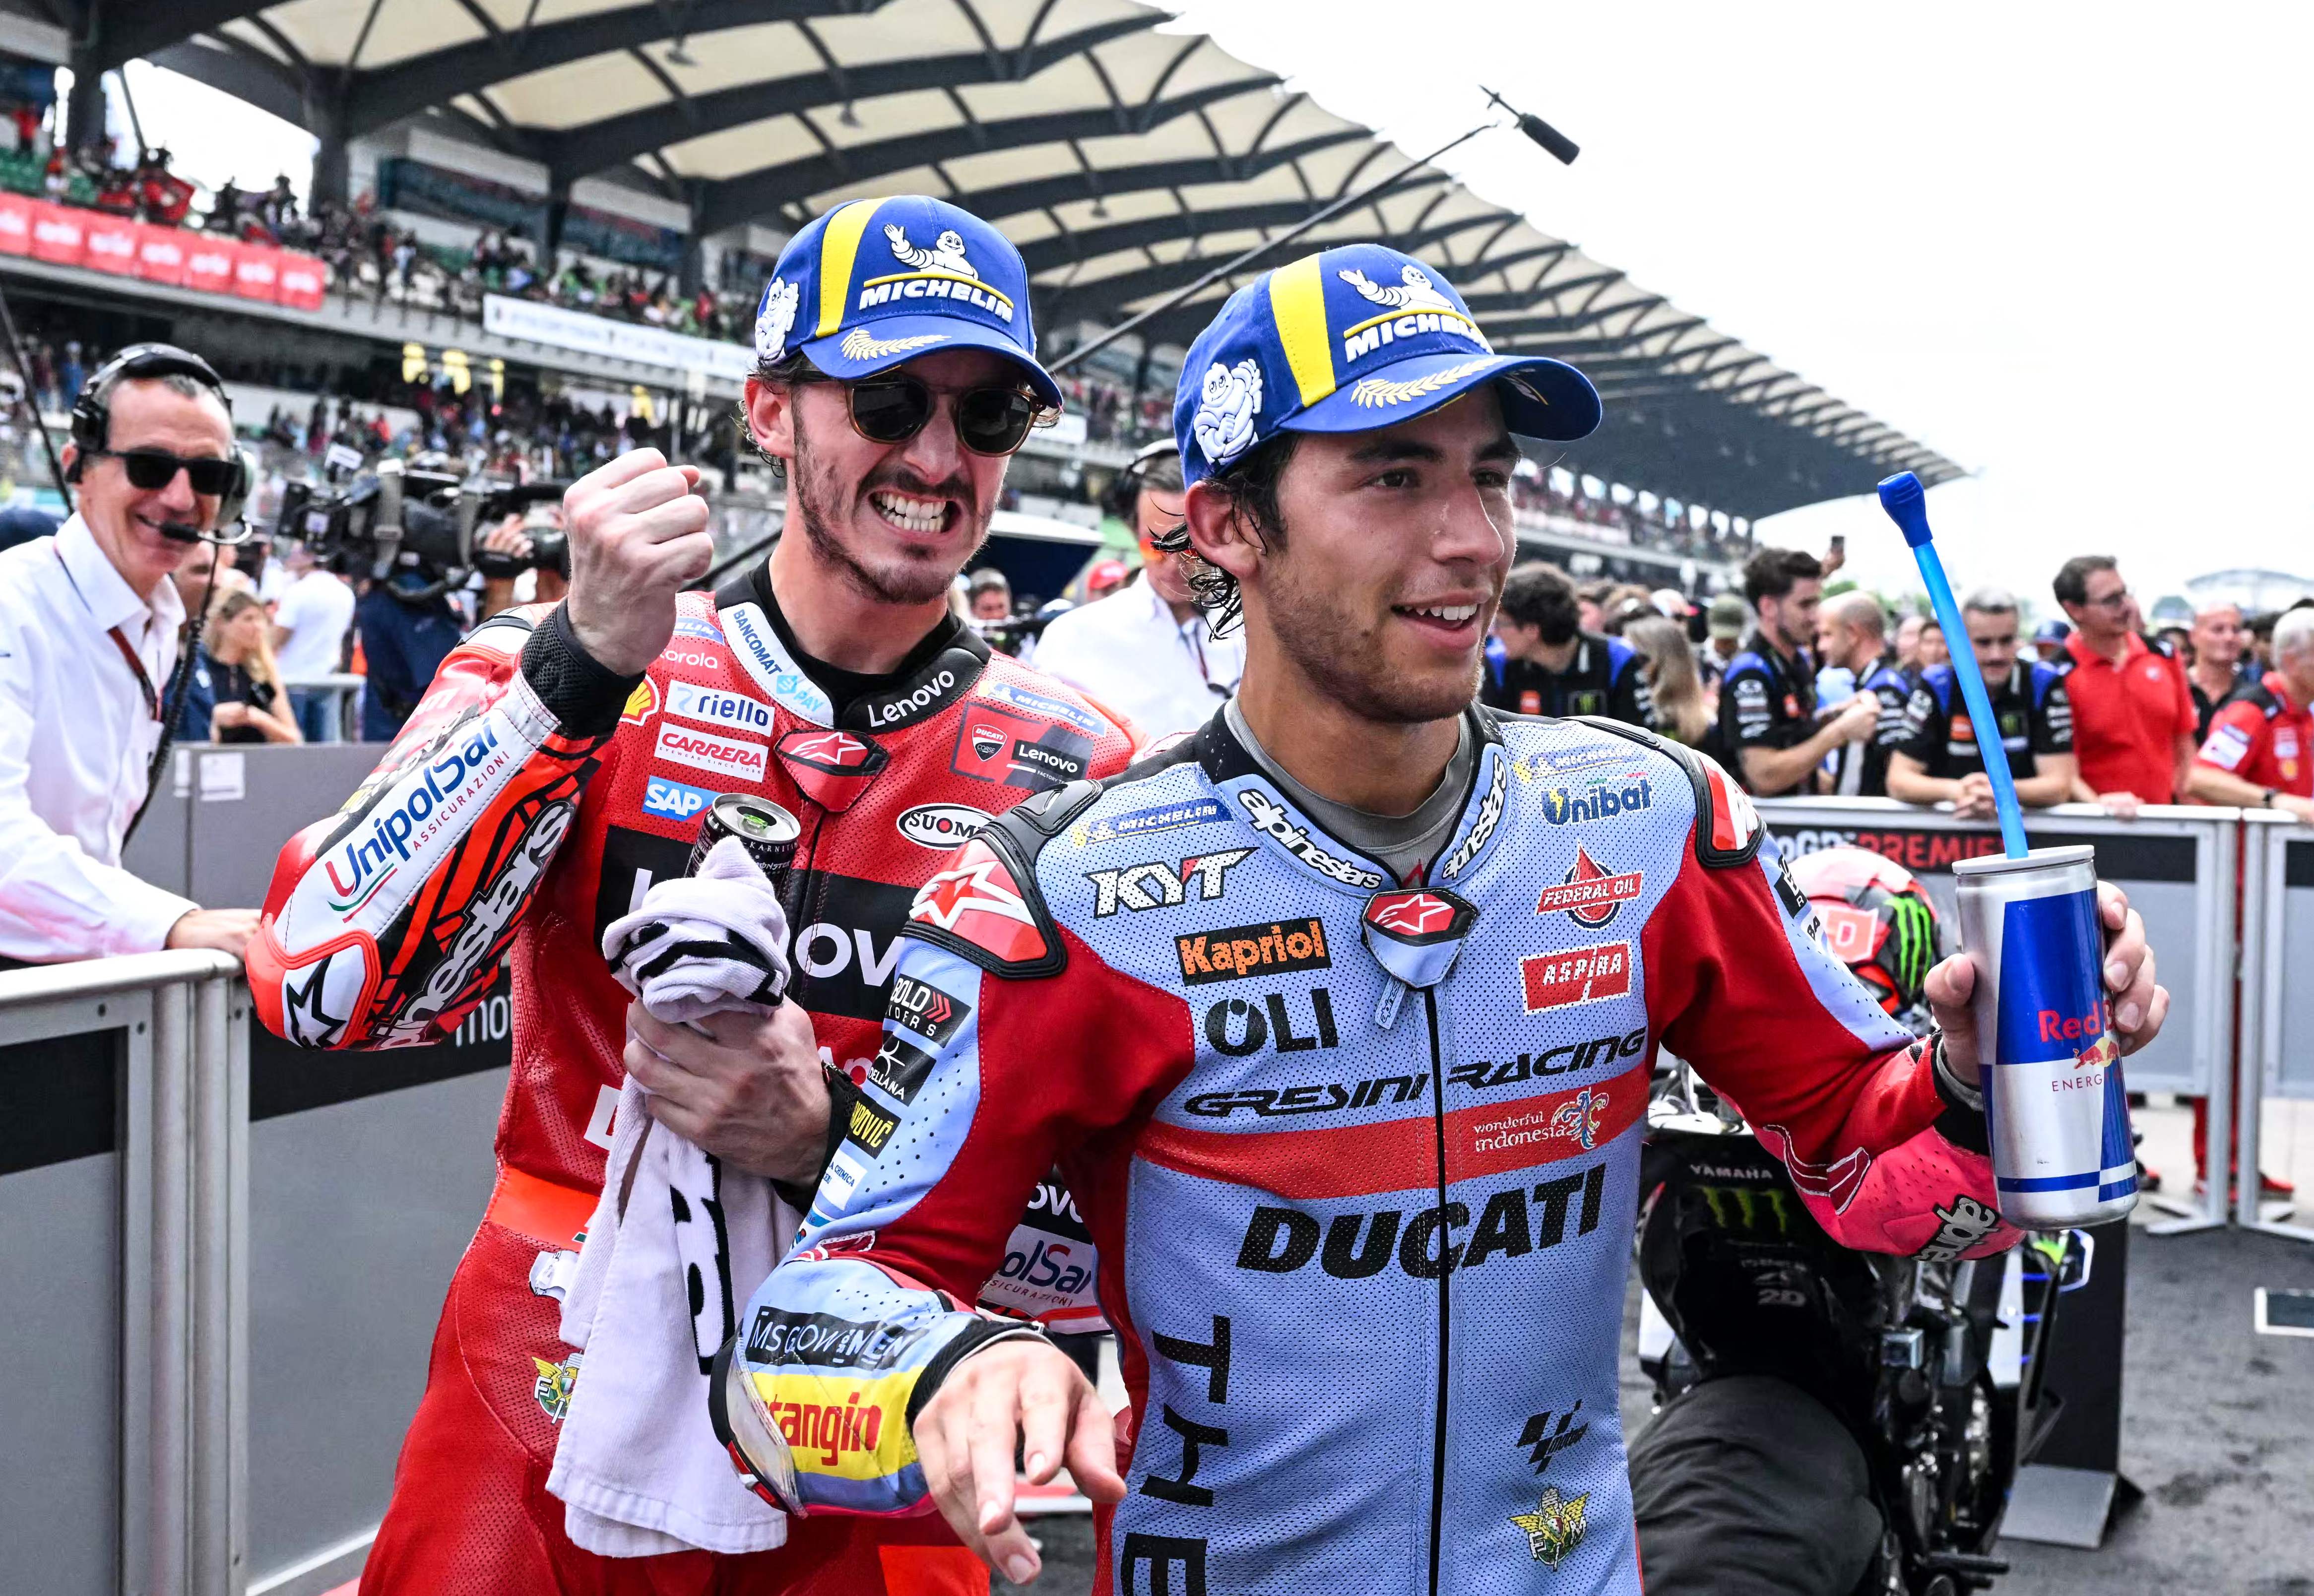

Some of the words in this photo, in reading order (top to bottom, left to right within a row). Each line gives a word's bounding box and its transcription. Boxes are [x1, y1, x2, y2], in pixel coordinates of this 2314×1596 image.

[859, 279, 1013, 323] MICHELIN
[660, 649, 718, 669] orola
[733, 609, 783, 675] BANCOMAT
[794, 690, 826, 712] PAY
[698, 694, 769, 726] riello
[867, 670, 955, 728] Lenovo
[1016, 694, 1096, 727] MICHELIN
[662, 733, 762, 768] CARRERA
[975, 728, 1004, 740] DUCATI
[977, 744, 995, 754] CORSE
[659, 746, 701, 761] EYEWEAR
[707, 759, 734, 768] SINCE
[1019, 744, 1078, 773] Lenovo
[1037, 770, 1058, 782] FACTORY
[325, 717, 499, 898] UnipolSai
[413, 751, 510, 851] ASSICURAZIONI
[645, 783, 703, 817] SAP
[1442, 752, 1508, 880] alpinestars
[1541, 778, 1652, 826] Unibat
[908, 811, 981, 838] SUOM
[1118, 804, 1218, 831] MICHELIN
[1238, 788, 1382, 889] alpinestars
[1858, 832, 2005, 868] PREMIE
[757, 860, 790, 871] ONSTER
[1082, 847, 1259, 919] KYT
[1543, 885, 1609, 906] FEDERAL
[1614, 878, 1636, 894] OIL
[1179, 921, 1327, 975] Kapriol
[891, 977, 931, 1012] BOLD
[885, 1005, 937, 1036] IDERS
[2038, 1000, 2101, 1042] Red
[868, 1067, 905, 1100] DELLANA
[1184, 1073, 1429, 1117] GRESINI
[1447, 1026, 1647, 1089] RACING
[2052, 1074, 2103, 1092] ENERG
[1474, 1111, 1544, 1134] wonderful
[1476, 1124, 1569, 1152] indonesia
[835, 1165, 855, 1187] CHIMICA
[1690, 1164, 1773, 1179] YAMAHA
[1236, 1163, 1606, 1279] DUCATI
[998, 1240, 1092, 1294] olSai
[990, 1280, 1073, 1307] SICURAZIONI
[750, 1319, 787, 1351] MS
[846, 1329, 914, 1360] MEN
